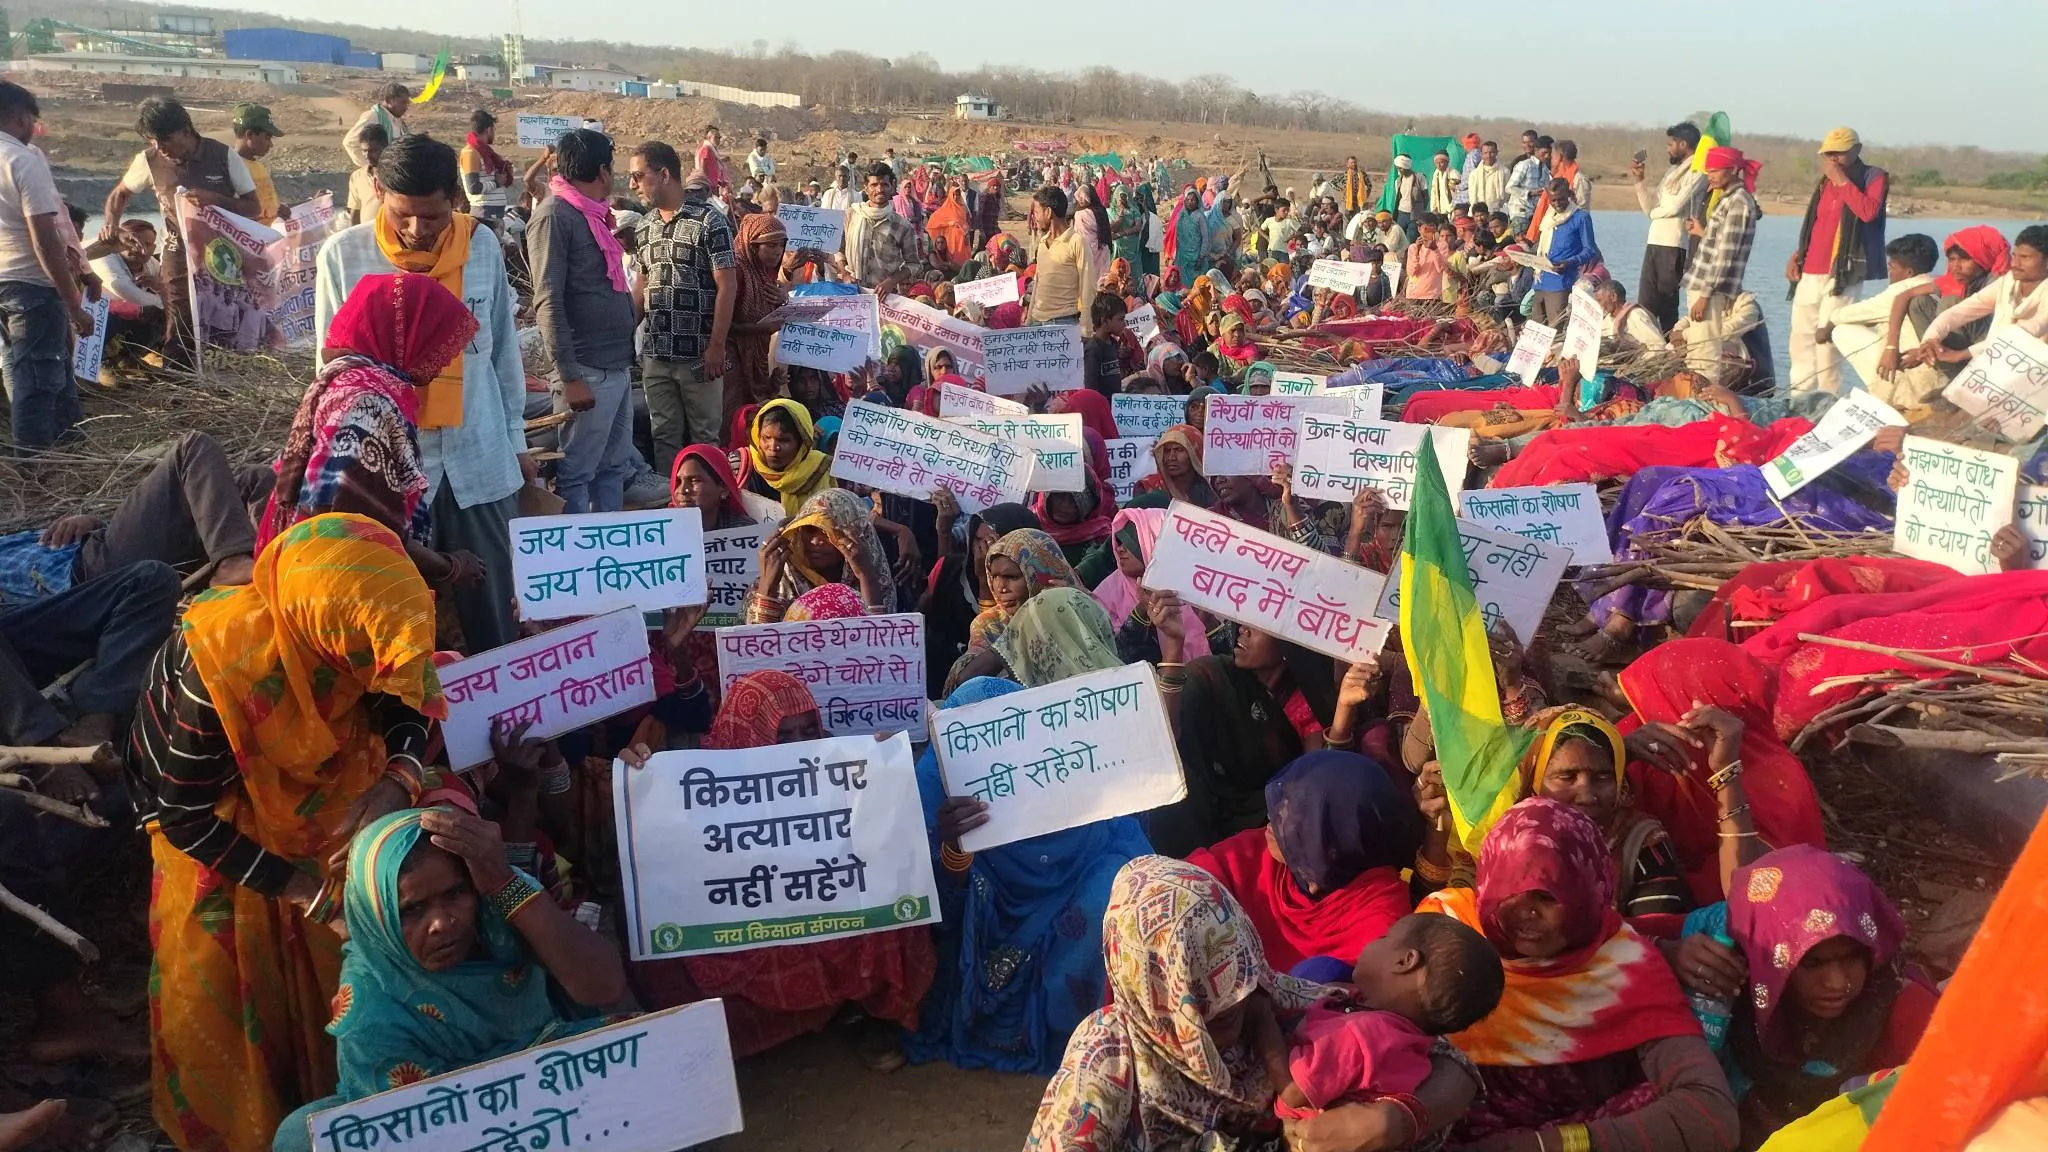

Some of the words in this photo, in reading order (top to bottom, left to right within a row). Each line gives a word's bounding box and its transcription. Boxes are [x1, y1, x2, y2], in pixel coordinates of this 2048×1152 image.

[935, 324, 960, 343] दमन
[1985, 337, 2048, 388] इंकला
[1142, 397, 1152, 411] के
[1153, 396, 1178, 412] बदले
[847, 425, 874, 446] को
[873, 436, 923, 458] न्याय
[1001, 420, 1021, 440] से
[1277, 426, 1298, 450] को
[838, 451, 878, 473] न्याय
[909, 462, 933, 487] तो
[1300, 464, 1325, 489] को
[1349, 451, 1417, 474] विस्थापि
[1465, 493, 1520, 520] किसानों
[1520, 496, 1542, 515] का
[1541, 490, 1582, 516] शोषण
[519, 525, 573, 555] जय
[574, 518, 673, 551] जवान
[1173, 514, 1240, 555] पहले
[1236, 539, 1311, 580] न्याय
[1904, 514, 1926, 545] को
[1928, 526, 1974, 556] न्याय
[523, 567, 584, 602] जय
[586, 553, 692, 594] किसान
[1192, 564, 1260, 612] बाद
[1258, 578, 1295, 620] में
[721, 628, 786, 657] पहले
[828, 622, 850, 649] थे
[441, 664, 502, 705] जय
[507, 630, 599, 681] जवान
[835, 655, 885, 685] चोरों
[488, 693, 547, 737] जय
[550, 656, 650, 714] किसान
[940, 706, 1032, 759] किसानों
[1036, 699, 1071, 731] का
[1072, 681, 1143, 722] शोषण
[679, 757, 822, 811] किसानों
[823, 758, 869, 792] पर
[703, 807, 853, 854] अत्याचार
[704, 864, 779, 909] नहीं
[780, 853, 867, 903] सहेंगे
[713, 928, 743, 945] जय
[747, 921, 806, 940] किसान
[807, 915, 866, 936] संगठन
[321, 1082, 471, 1152] किसानों
[472, 1072, 526, 1117] का
[533, 1030, 649, 1098] शोषण
